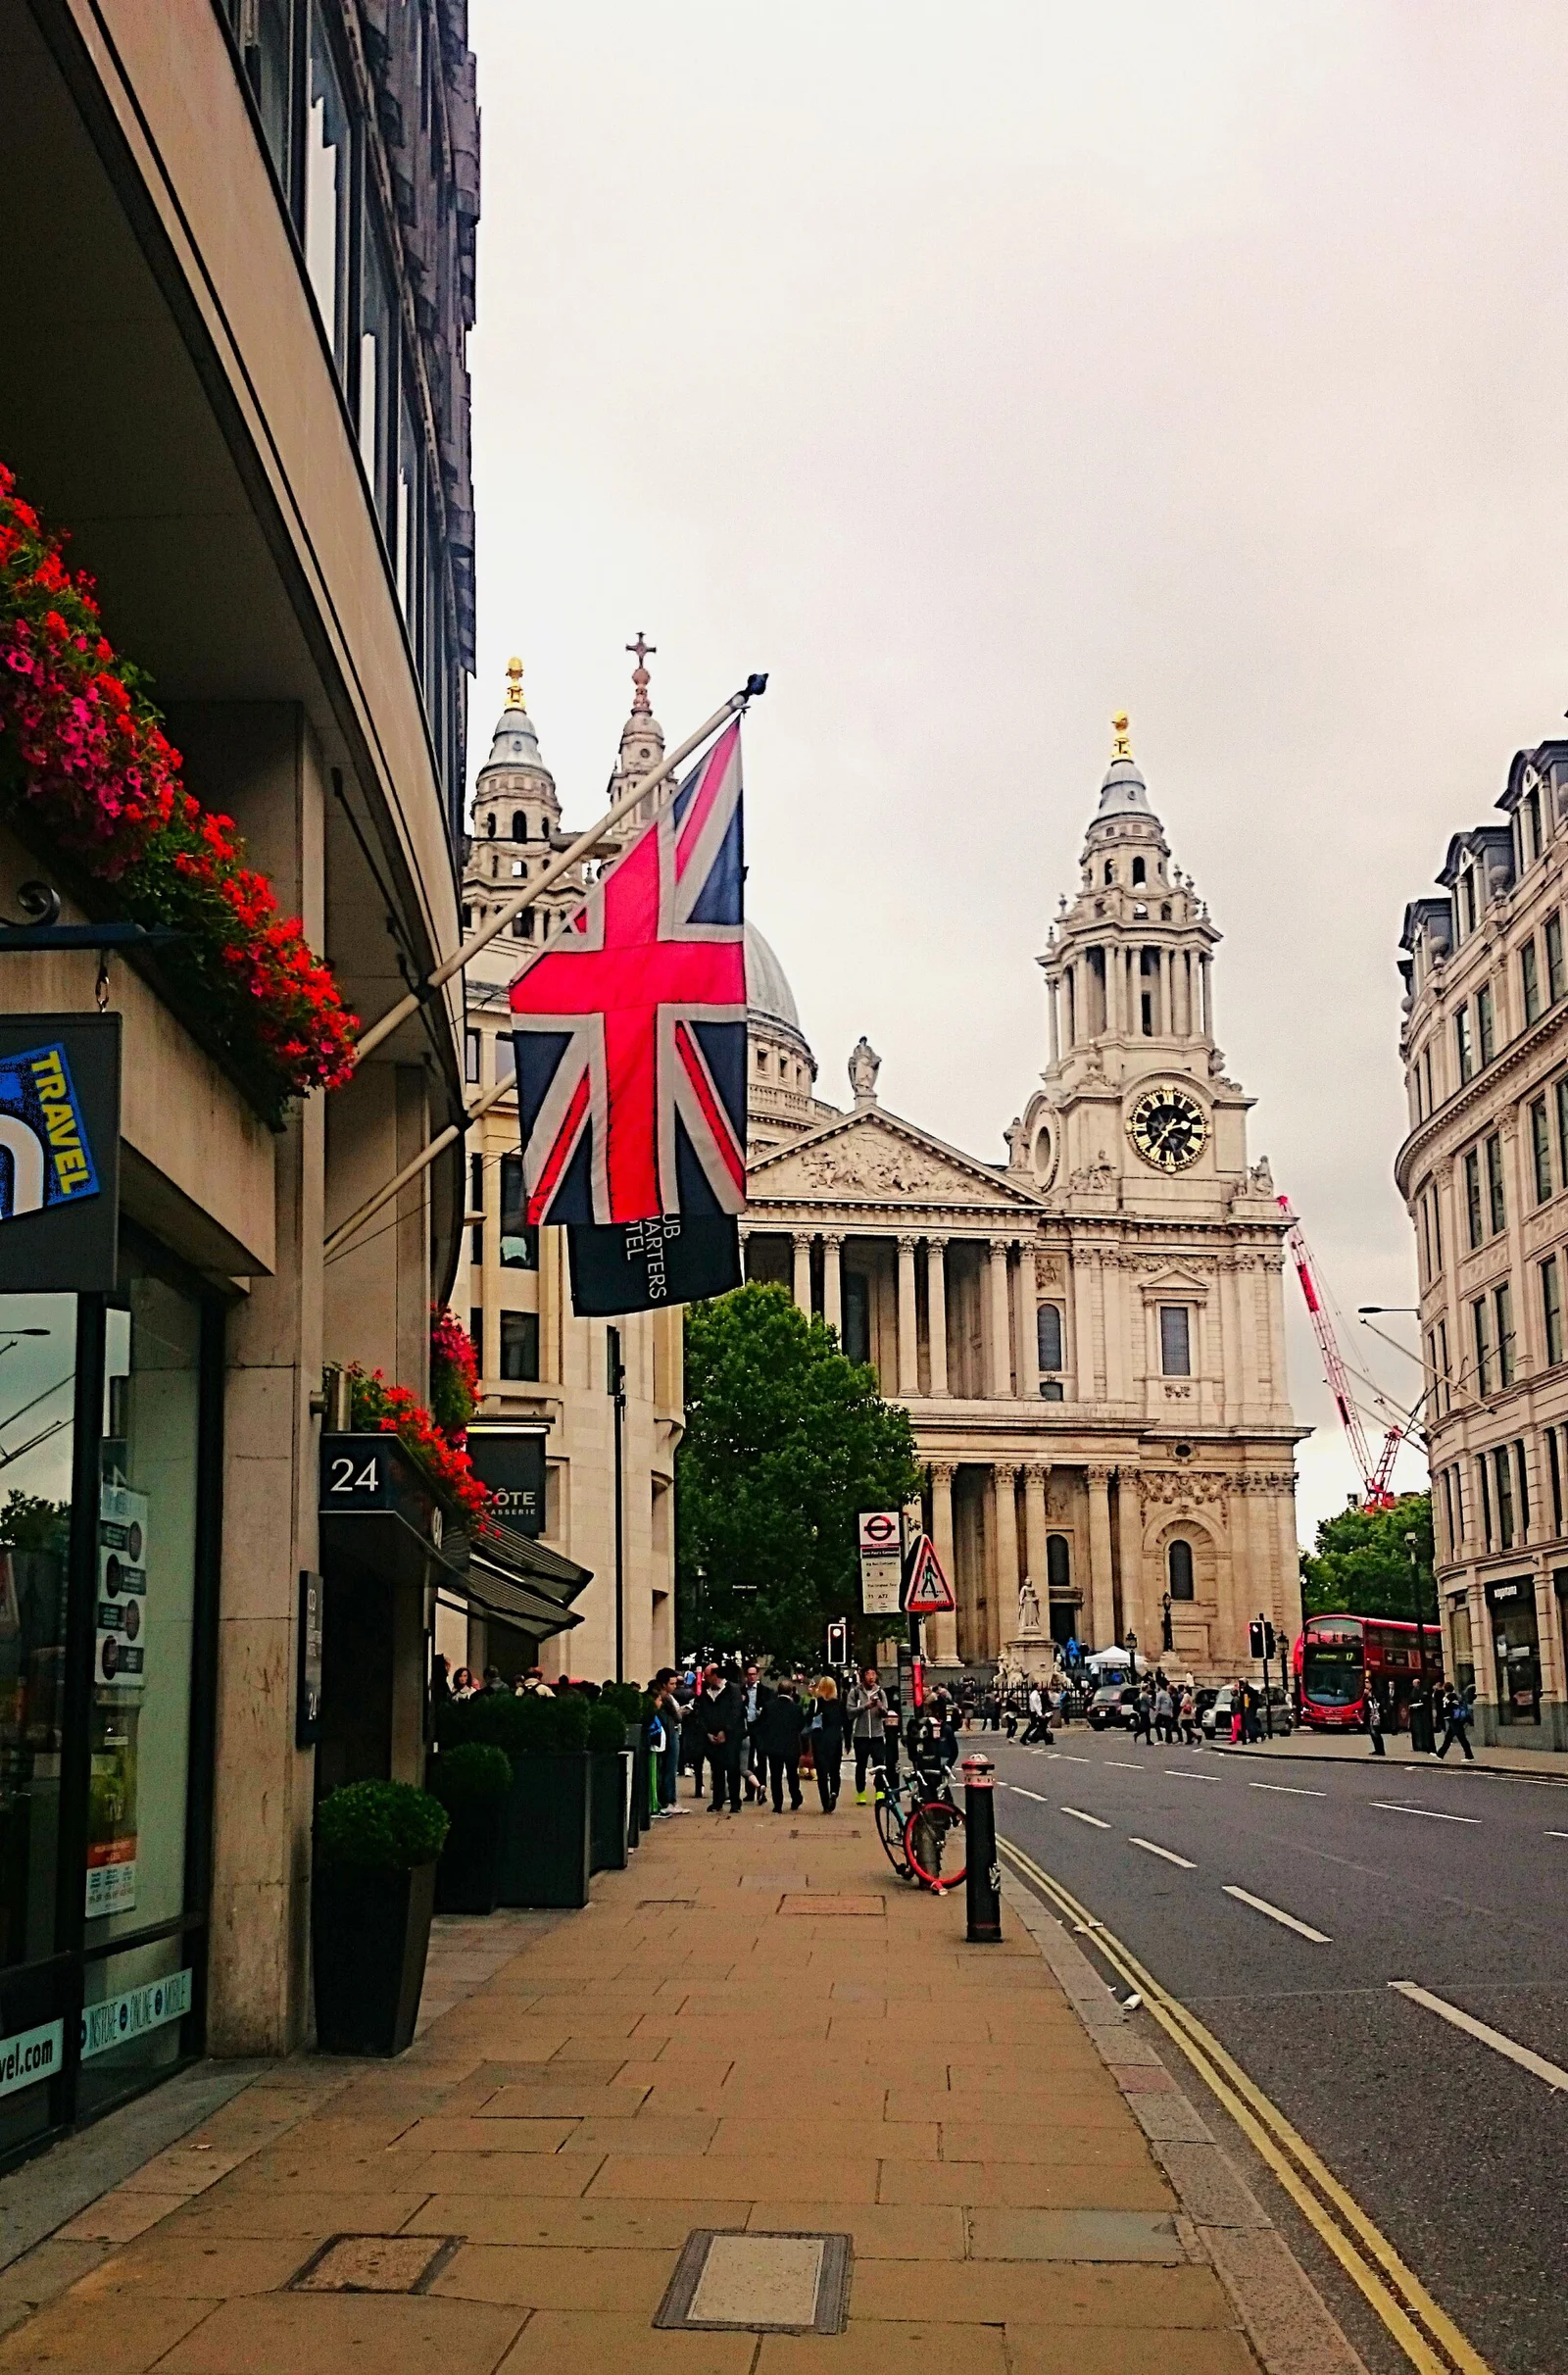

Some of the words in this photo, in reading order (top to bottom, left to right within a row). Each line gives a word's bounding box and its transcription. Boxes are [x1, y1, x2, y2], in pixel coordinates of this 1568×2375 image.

[31, 1051, 89, 1195] TRAVEL
[330, 1458, 379, 1493] 24
[480, 1487, 536, 1506] CÔTE
[1346, 1652, 1354, 1660] 17
[89, 2002, 118, 2051] INSTORE
[129, 1988, 153, 2033] ONLINE
[164, 1975, 186, 2017] MOBILE
[0, 2038, 54, 2083] vel.com
